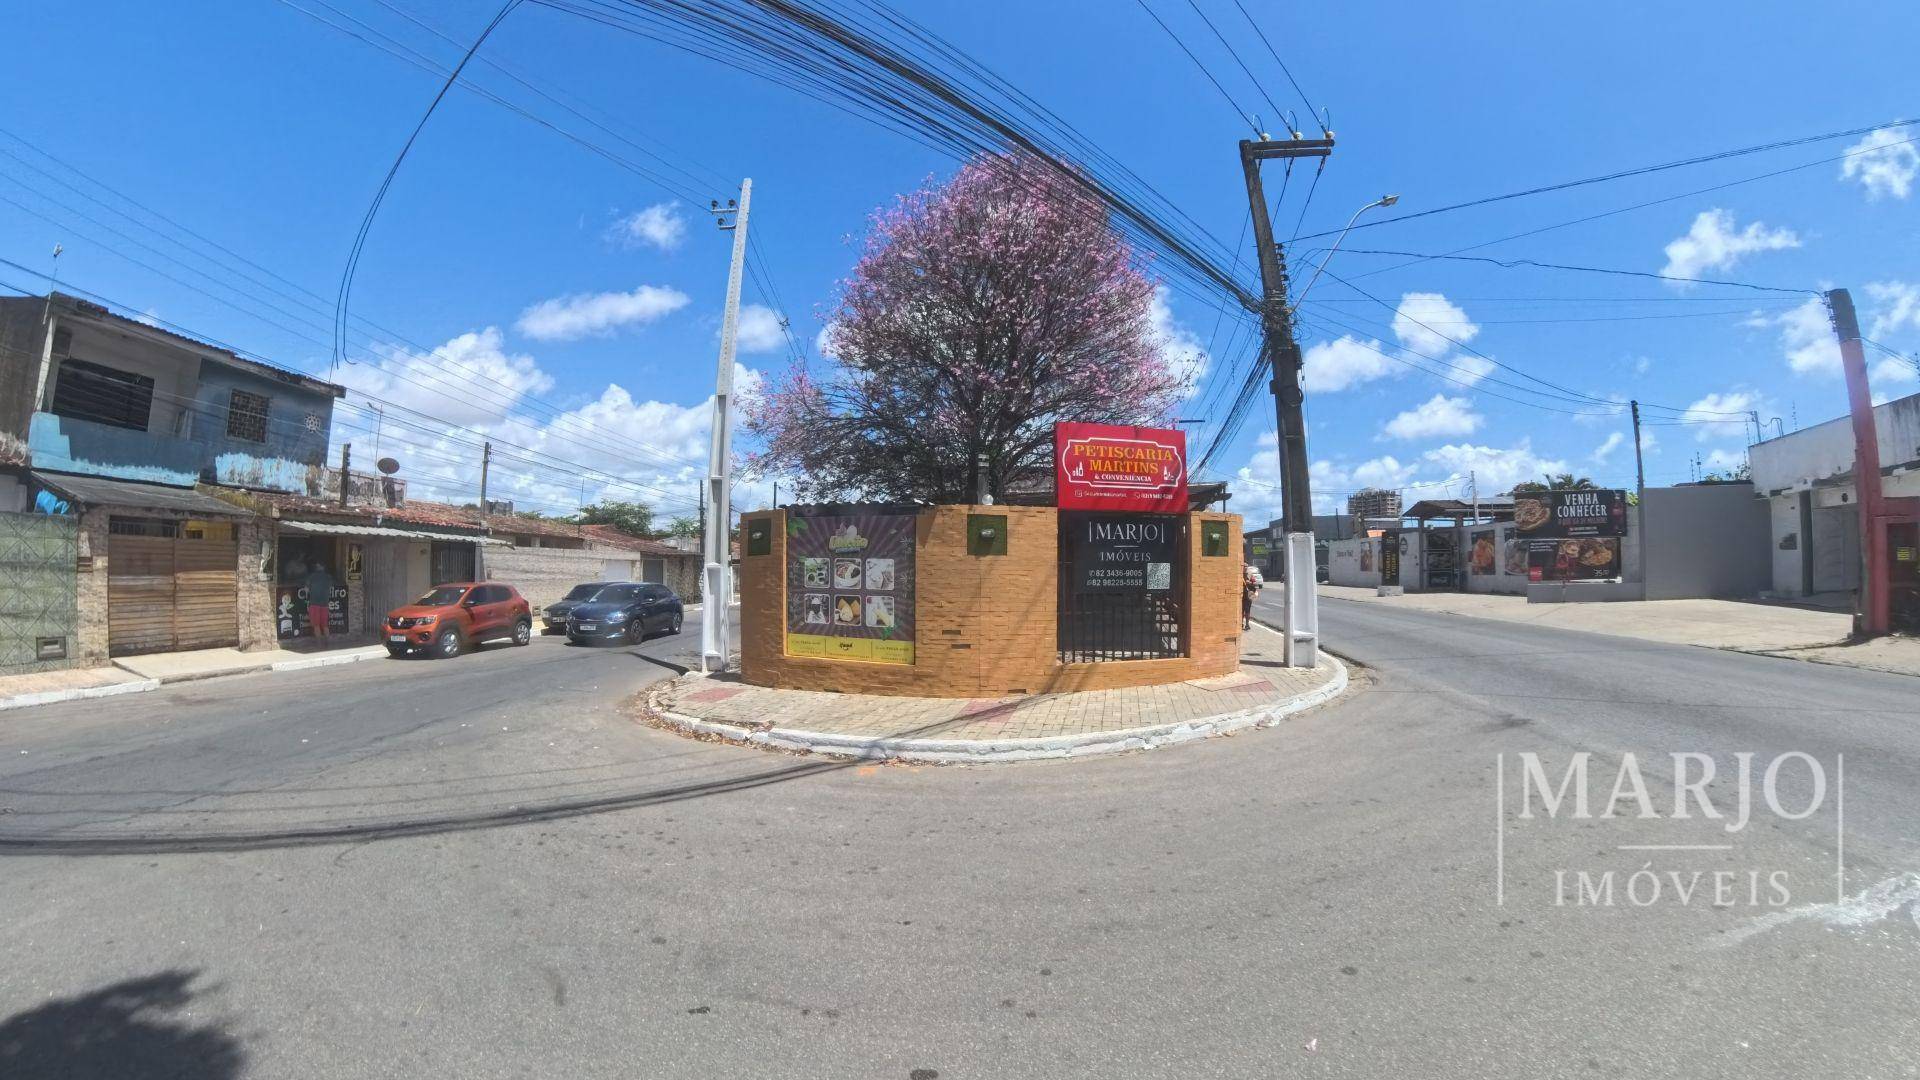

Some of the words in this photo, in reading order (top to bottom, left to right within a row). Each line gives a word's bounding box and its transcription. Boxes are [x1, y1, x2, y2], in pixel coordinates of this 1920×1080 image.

[1073, 444, 1173, 461] PETISCARIA
[1089, 459, 1159, 474] MARTINS
[1564, 493, 1599, 506] VENHA
[1557, 504, 1608, 517] CONHECER
[1096, 523, 1158, 543] MARJO
[1101, 549, 1151, 561] IMÓVEIS
[1095, 569, 1105, 577] 82
